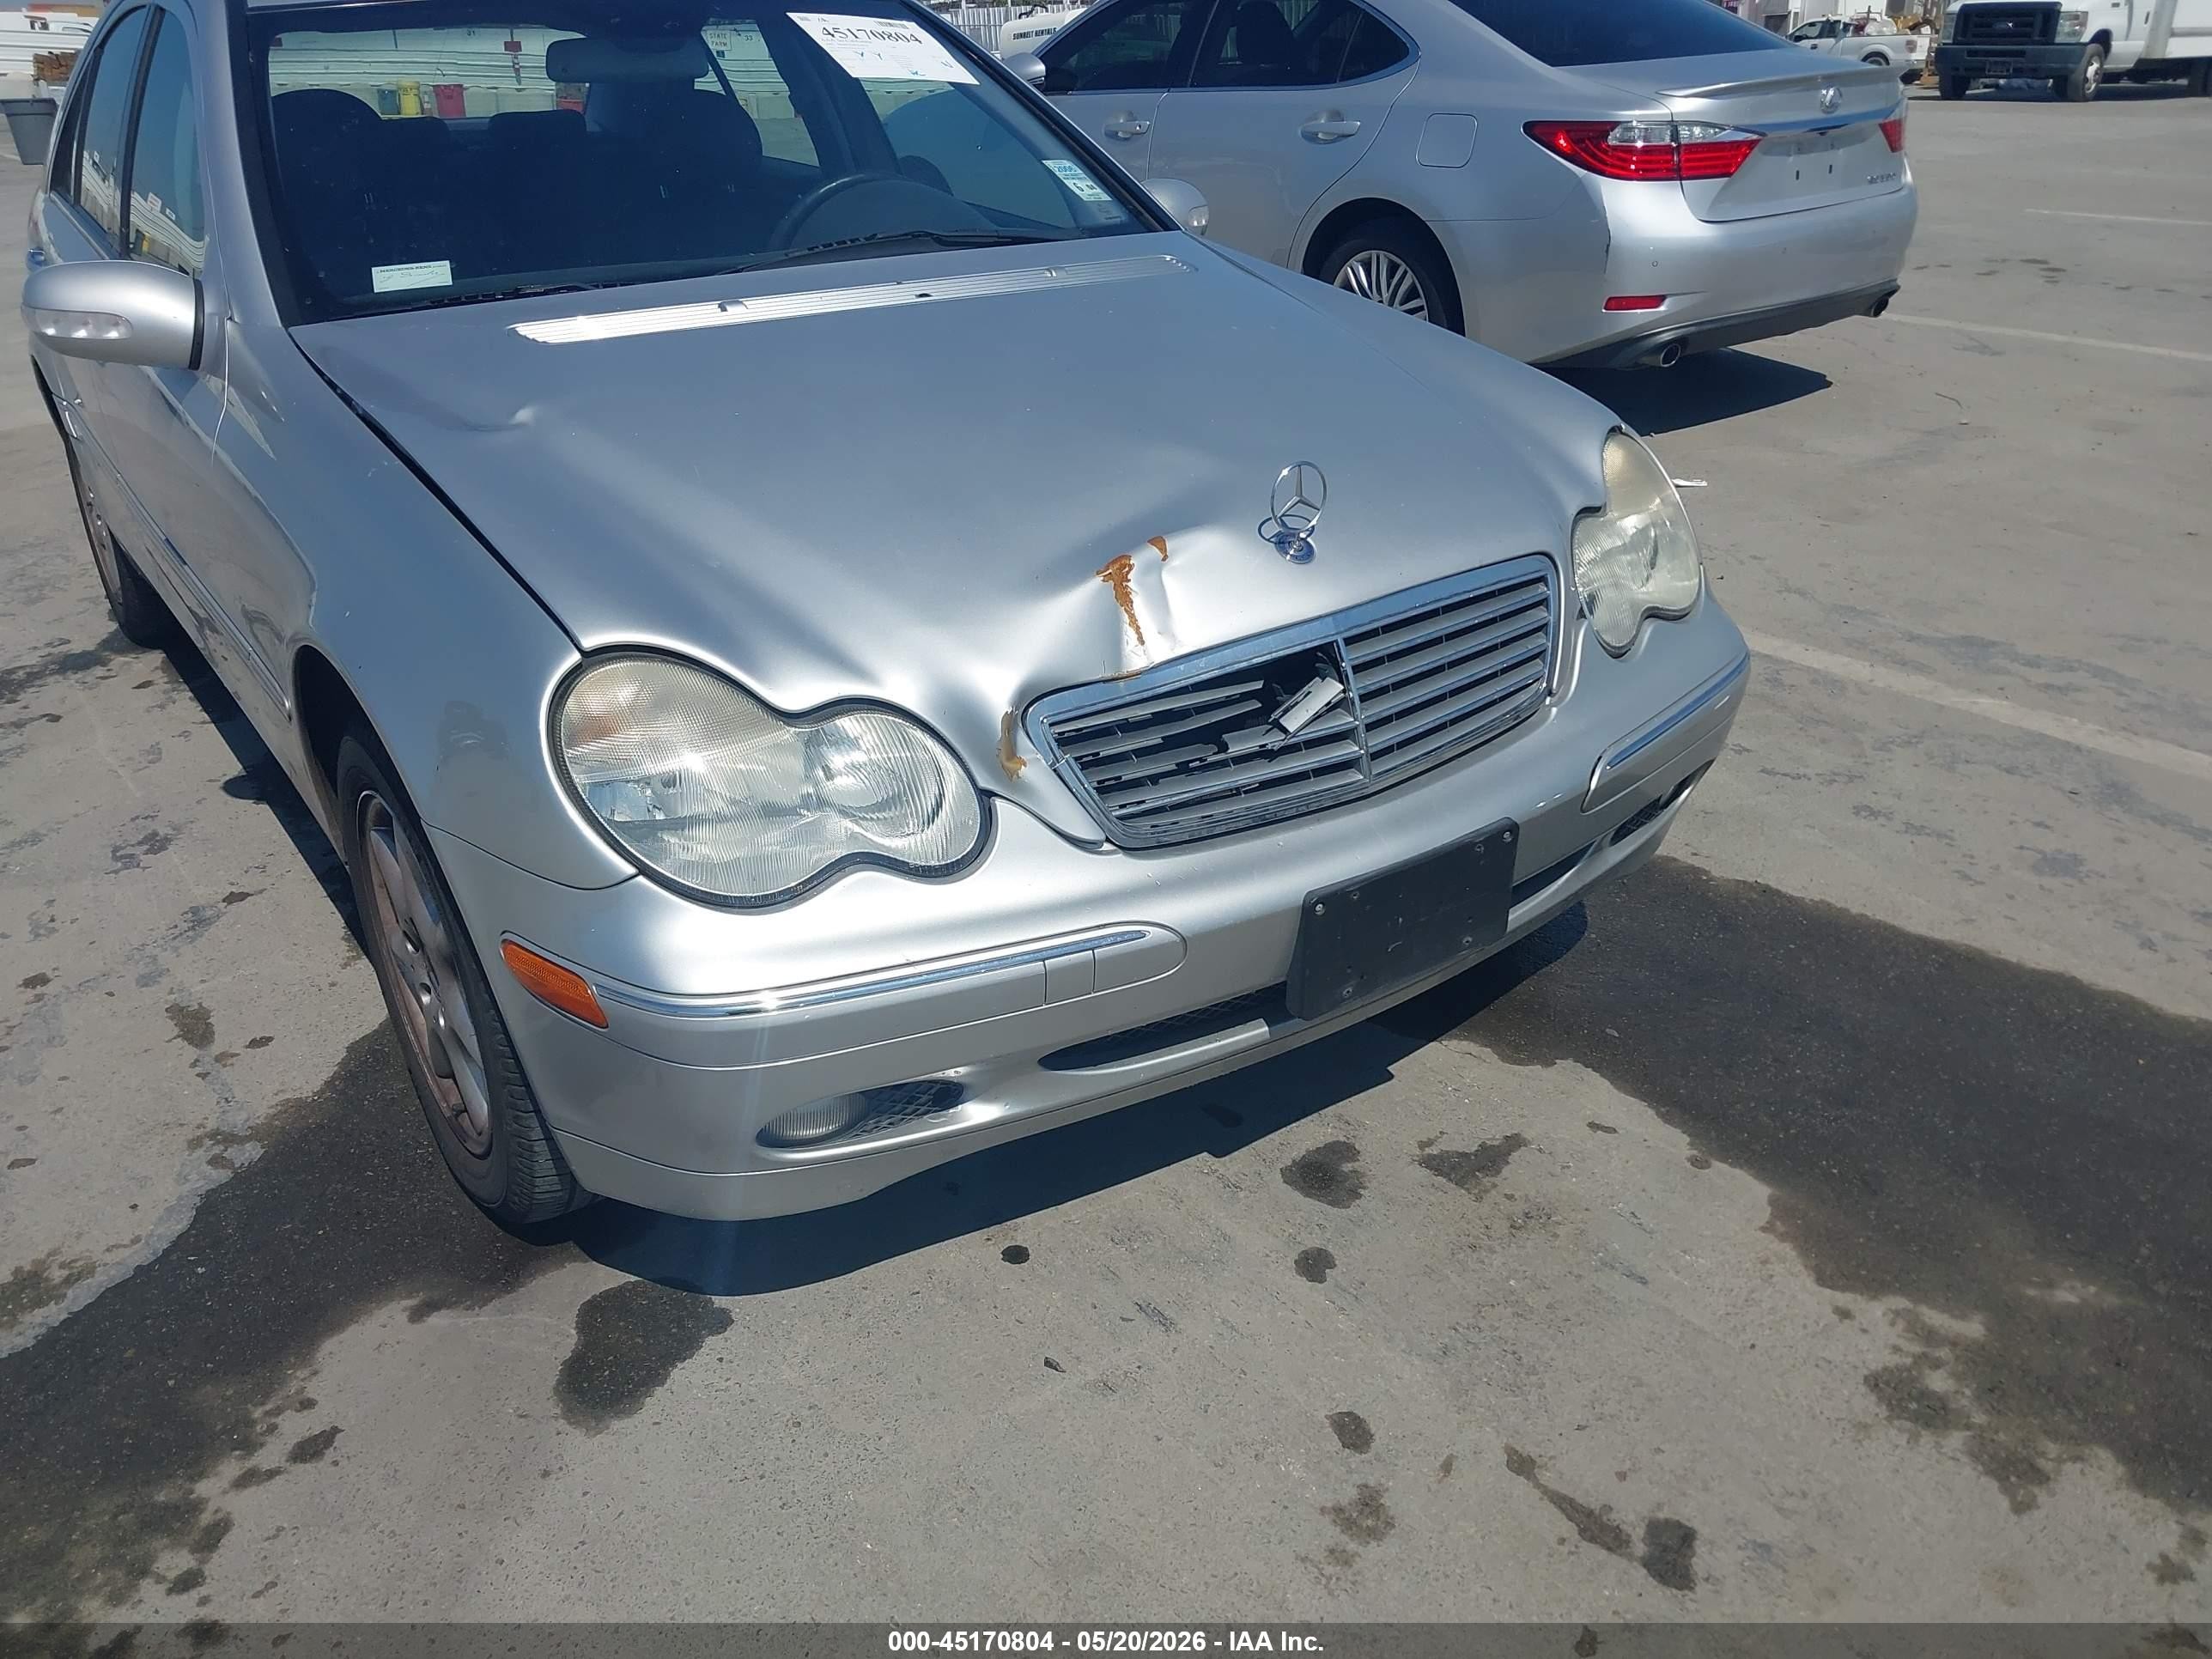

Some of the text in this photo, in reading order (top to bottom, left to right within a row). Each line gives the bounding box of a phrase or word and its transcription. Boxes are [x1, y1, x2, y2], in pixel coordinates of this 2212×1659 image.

[822, 27, 923, 45] 45170804
[1012, 27, 1057, 40] SUNBELT RENTALS
[1073, 182, 1085, 192] 6
